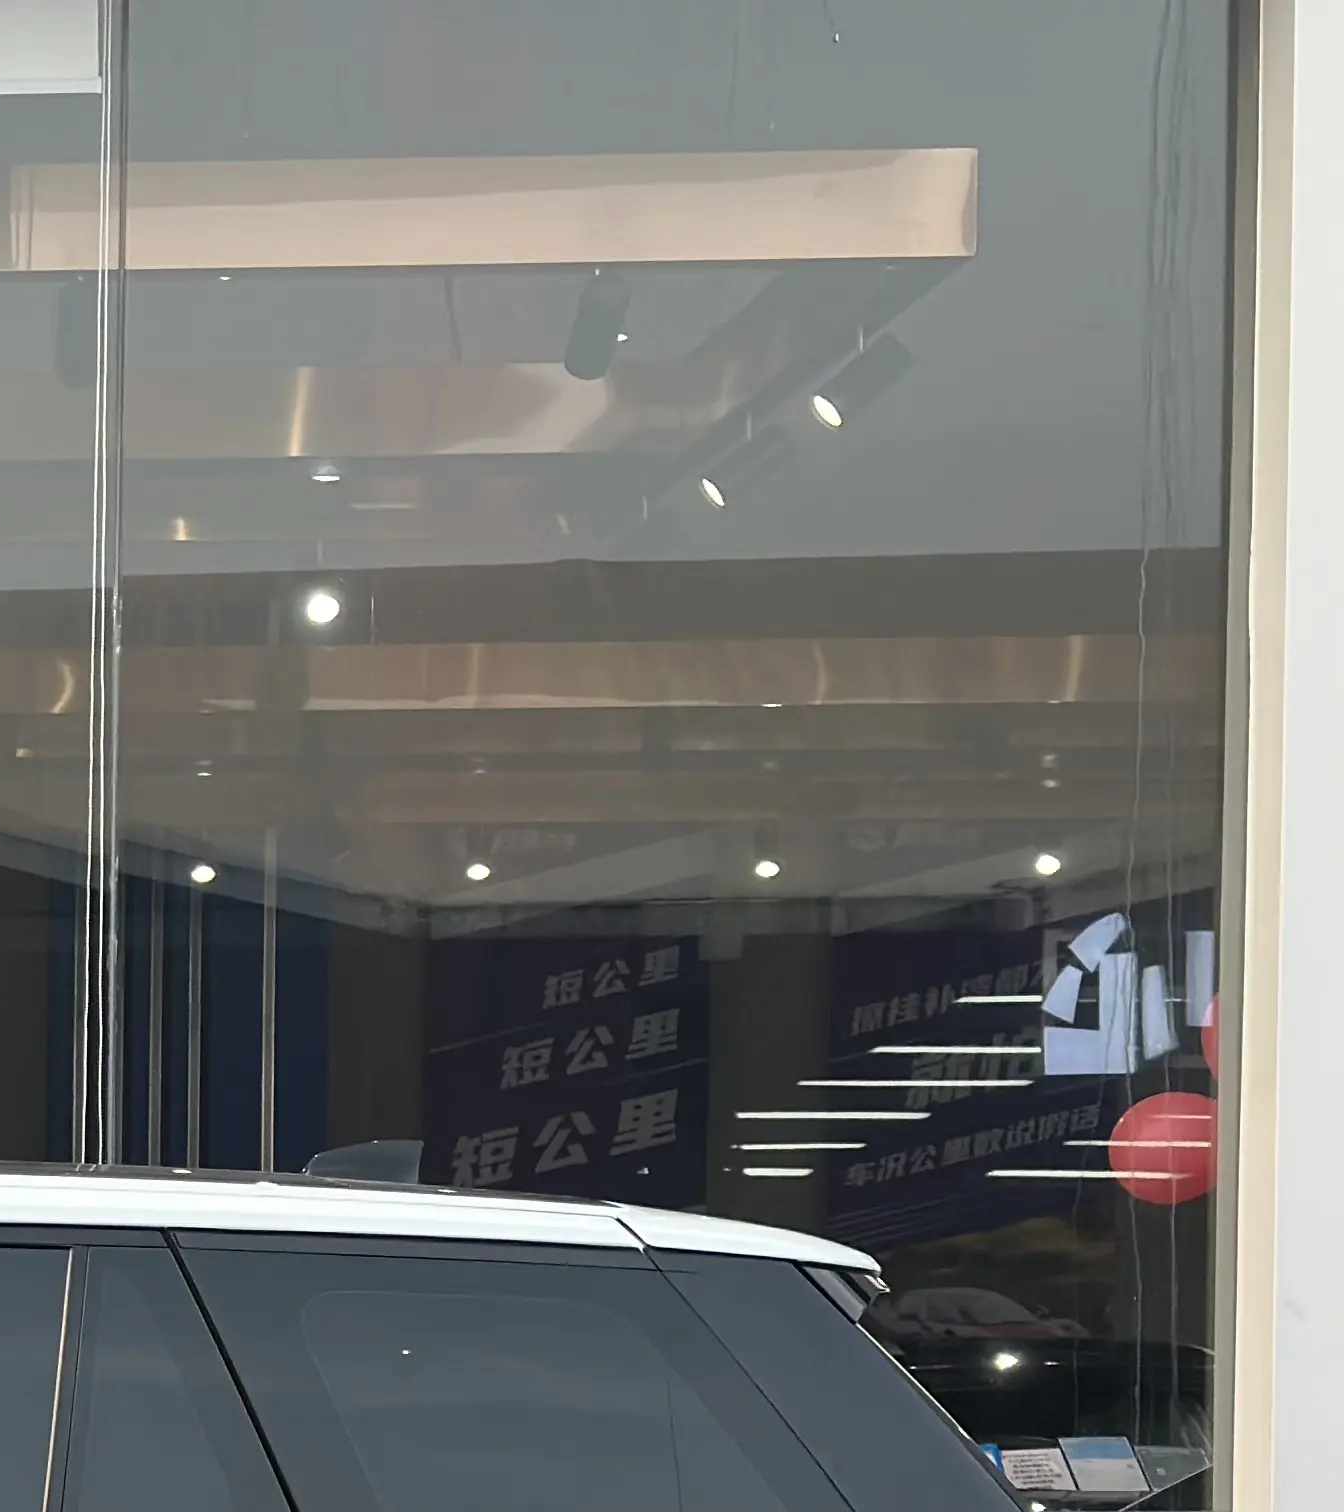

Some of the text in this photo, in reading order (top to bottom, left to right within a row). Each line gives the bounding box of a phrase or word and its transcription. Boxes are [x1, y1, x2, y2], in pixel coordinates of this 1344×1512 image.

[543, 946, 680, 1008] 短公里
[500, 1008, 679, 1089] 短公里
[451, 1088, 679, 1188] 短公里
